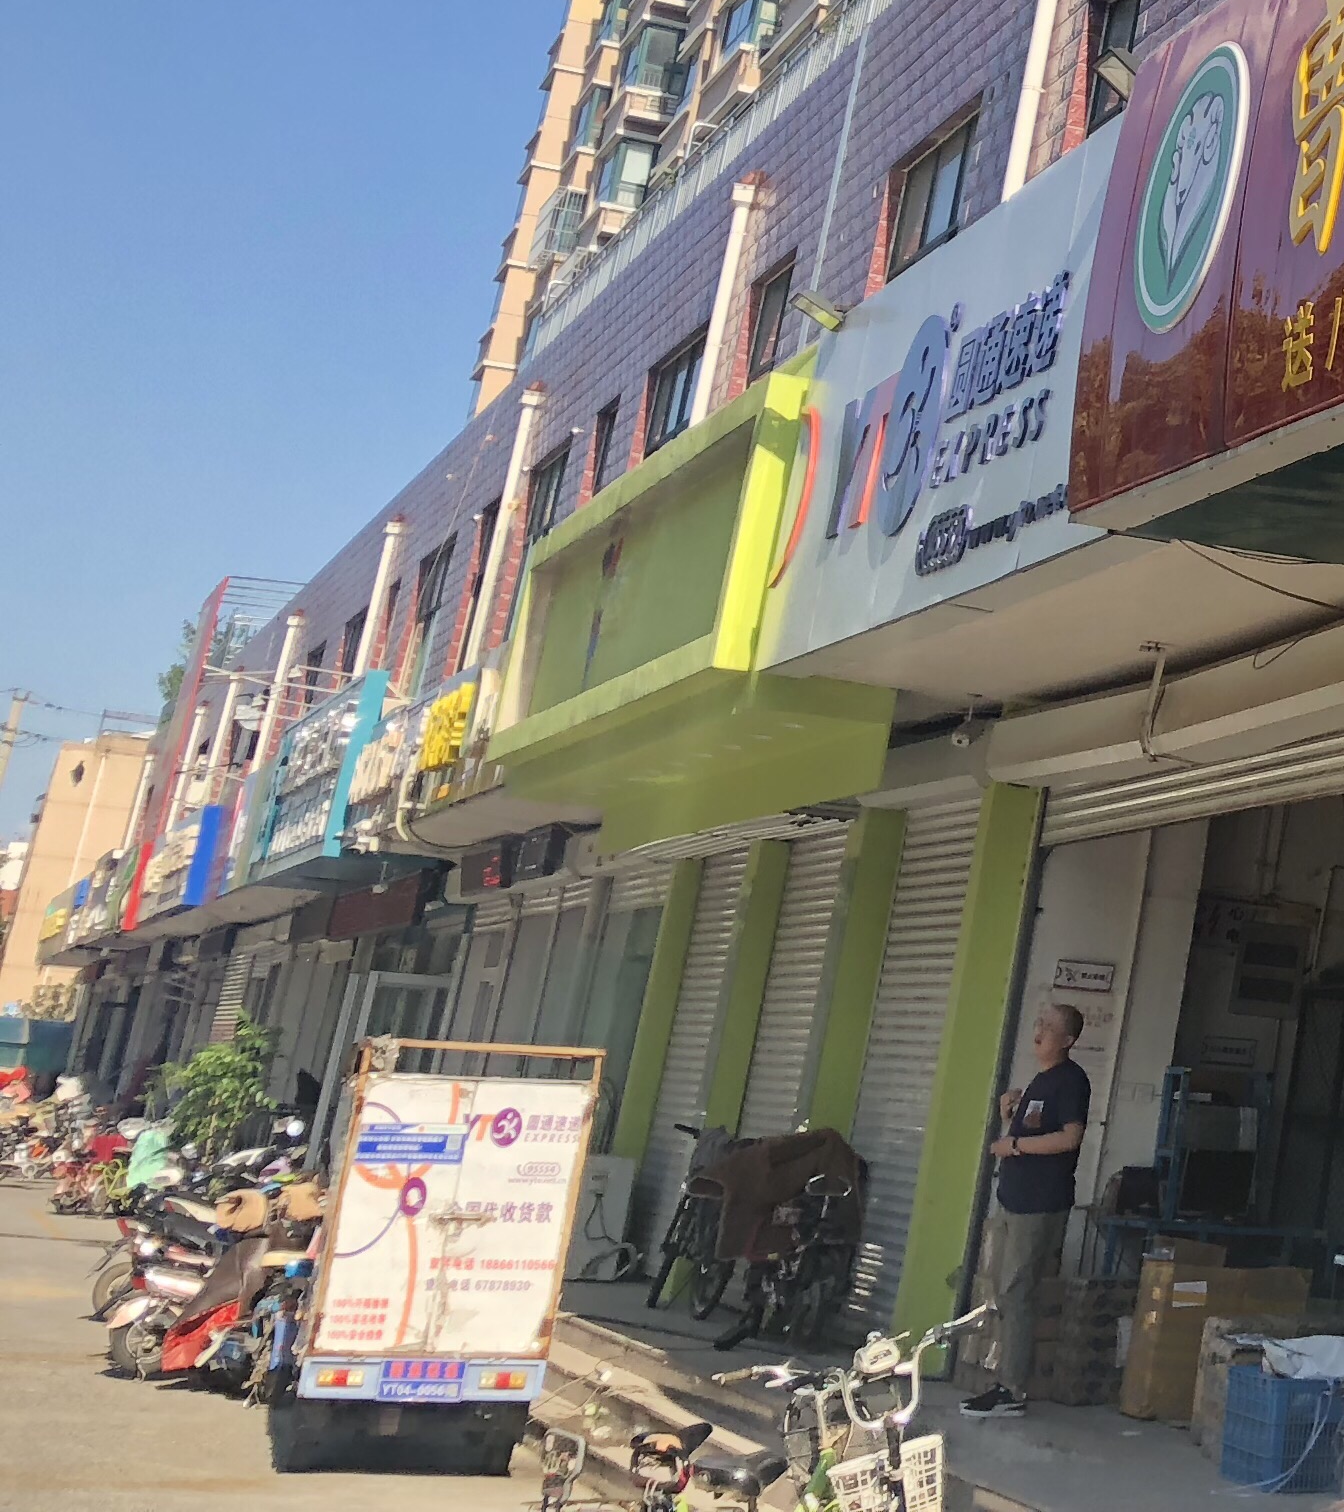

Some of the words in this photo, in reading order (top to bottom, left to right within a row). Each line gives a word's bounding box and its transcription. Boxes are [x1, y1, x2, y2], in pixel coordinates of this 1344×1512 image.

[944, 269, 1071, 424] 圆通速递
[930, 388, 1052, 489] EXPRESS
